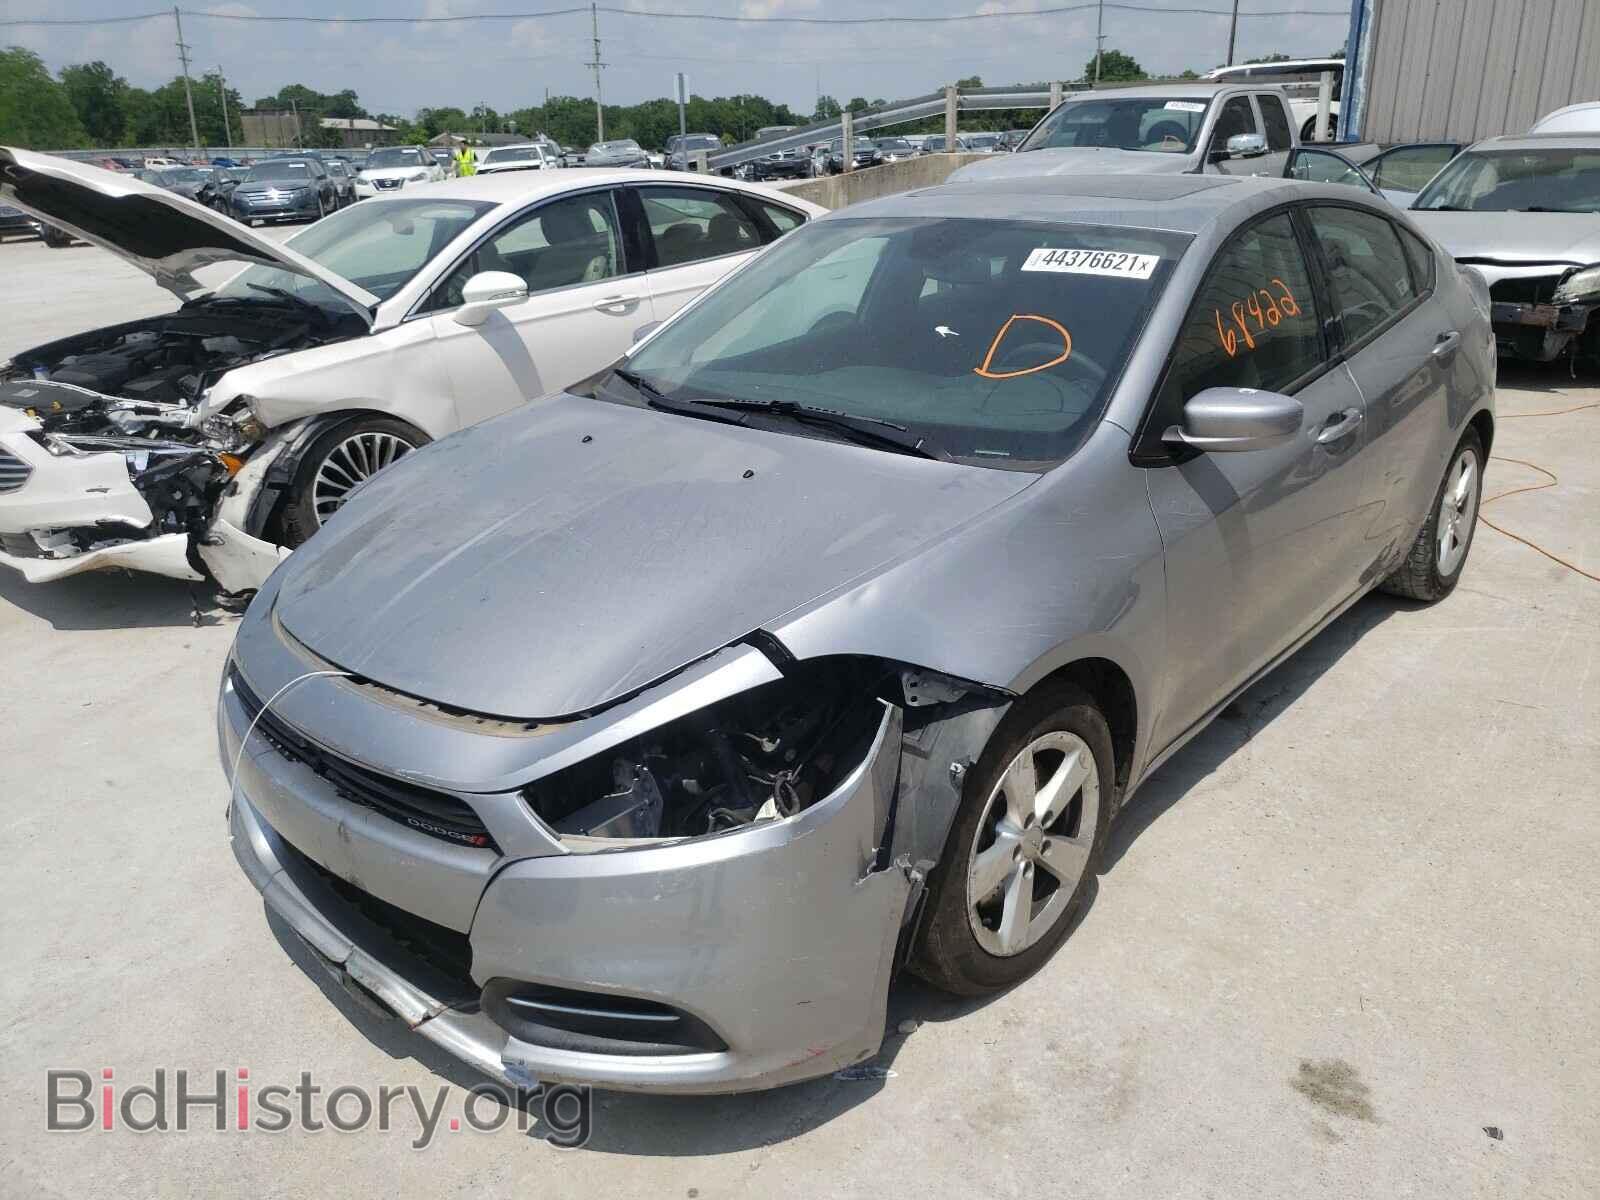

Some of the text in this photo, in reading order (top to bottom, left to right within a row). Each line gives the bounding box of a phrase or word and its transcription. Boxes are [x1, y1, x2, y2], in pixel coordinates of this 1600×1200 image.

[1041, 249, 1140, 271] 44376621
[1215, 279, 1302, 357] 68422
[973, 313, 1072, 379] D
[407, 817, 474, 844] DODGE
